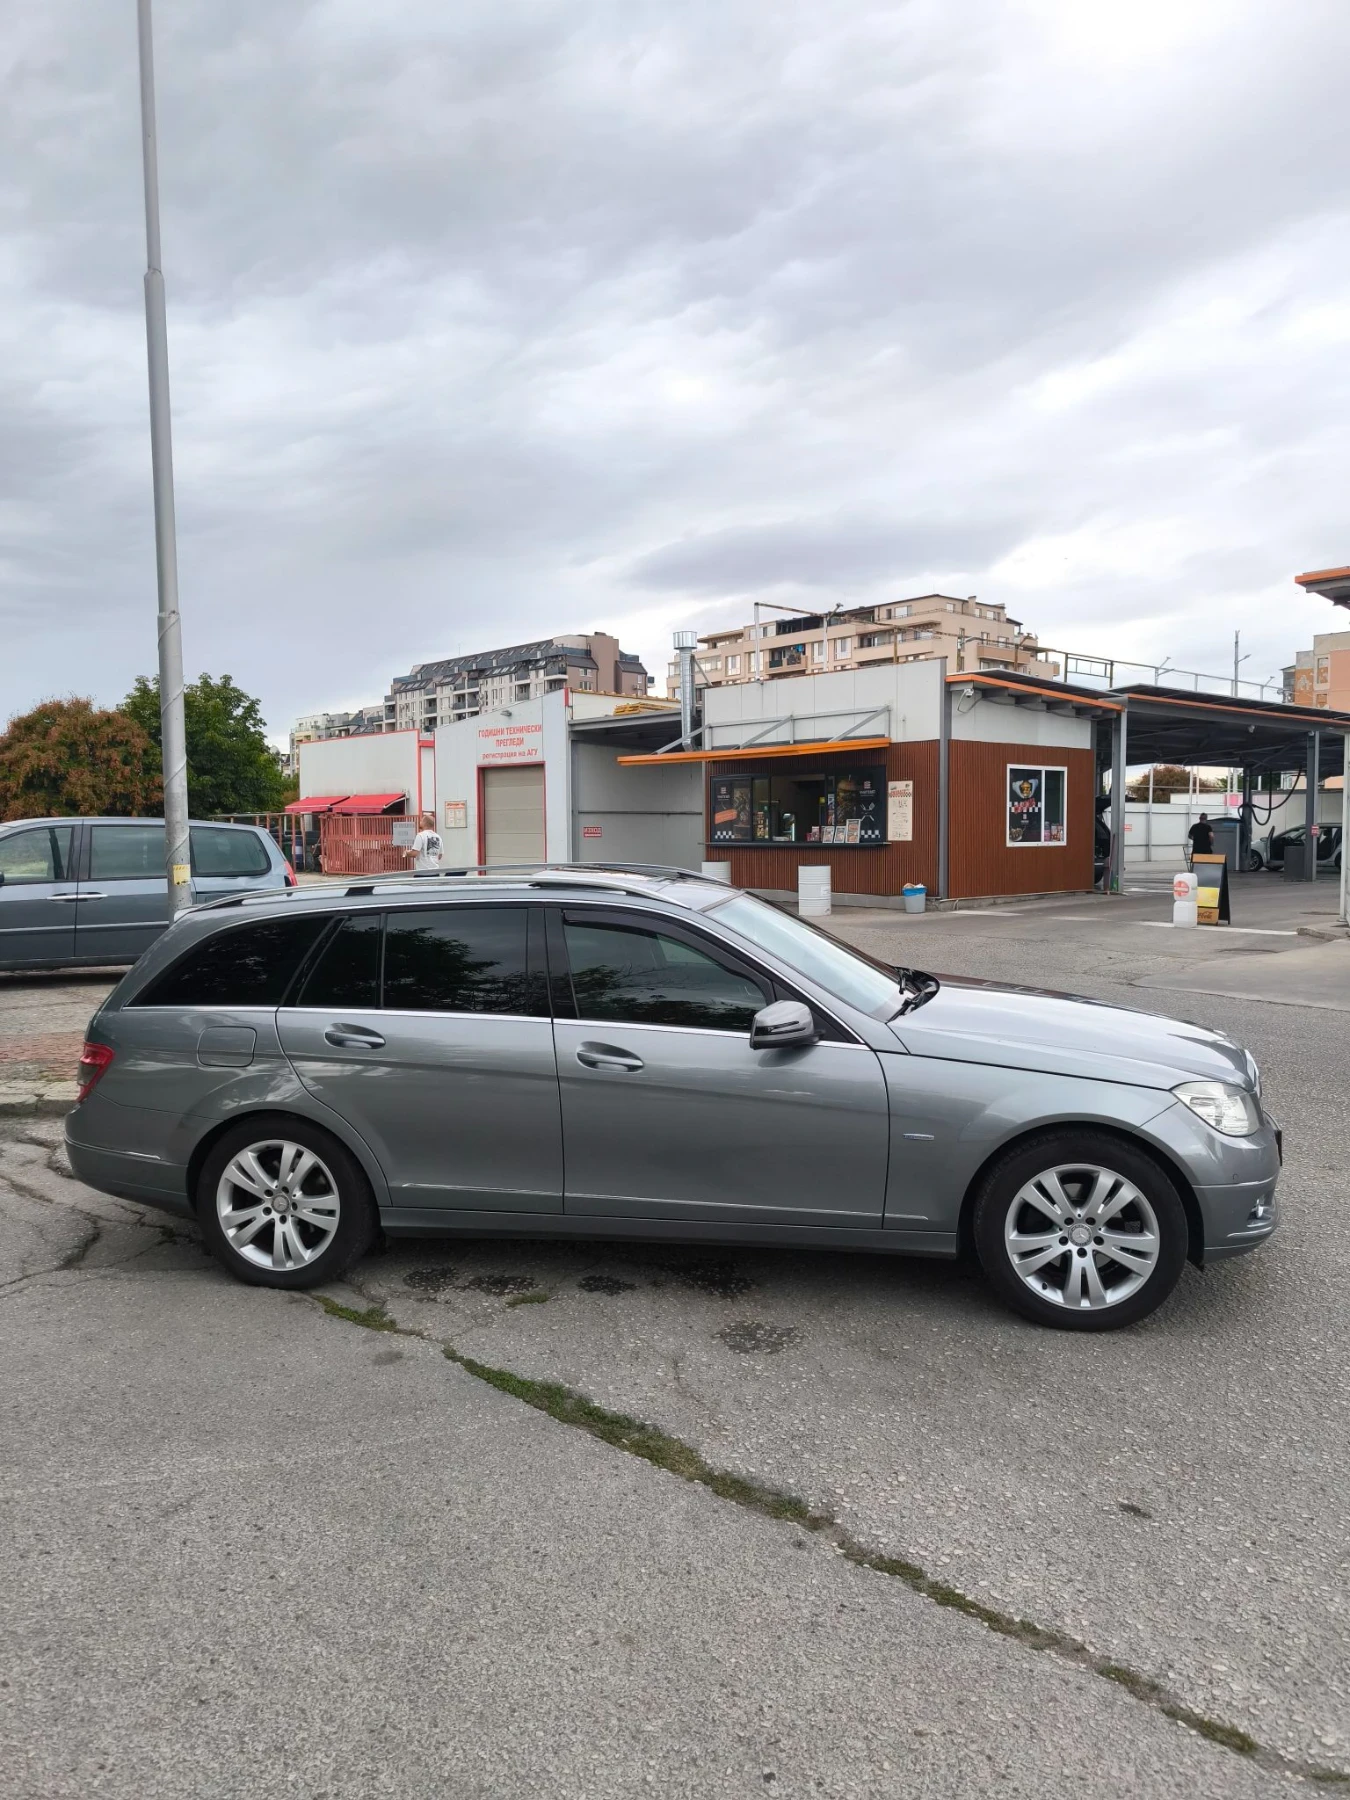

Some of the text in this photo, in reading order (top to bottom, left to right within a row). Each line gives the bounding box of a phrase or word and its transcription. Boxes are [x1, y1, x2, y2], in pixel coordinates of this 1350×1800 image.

[479, 725, 542, 738] ГОДИШНИ ТЕХНИЧЕСКИ
[496, 737, 524, 747] ПРЕГЛЕДИ
